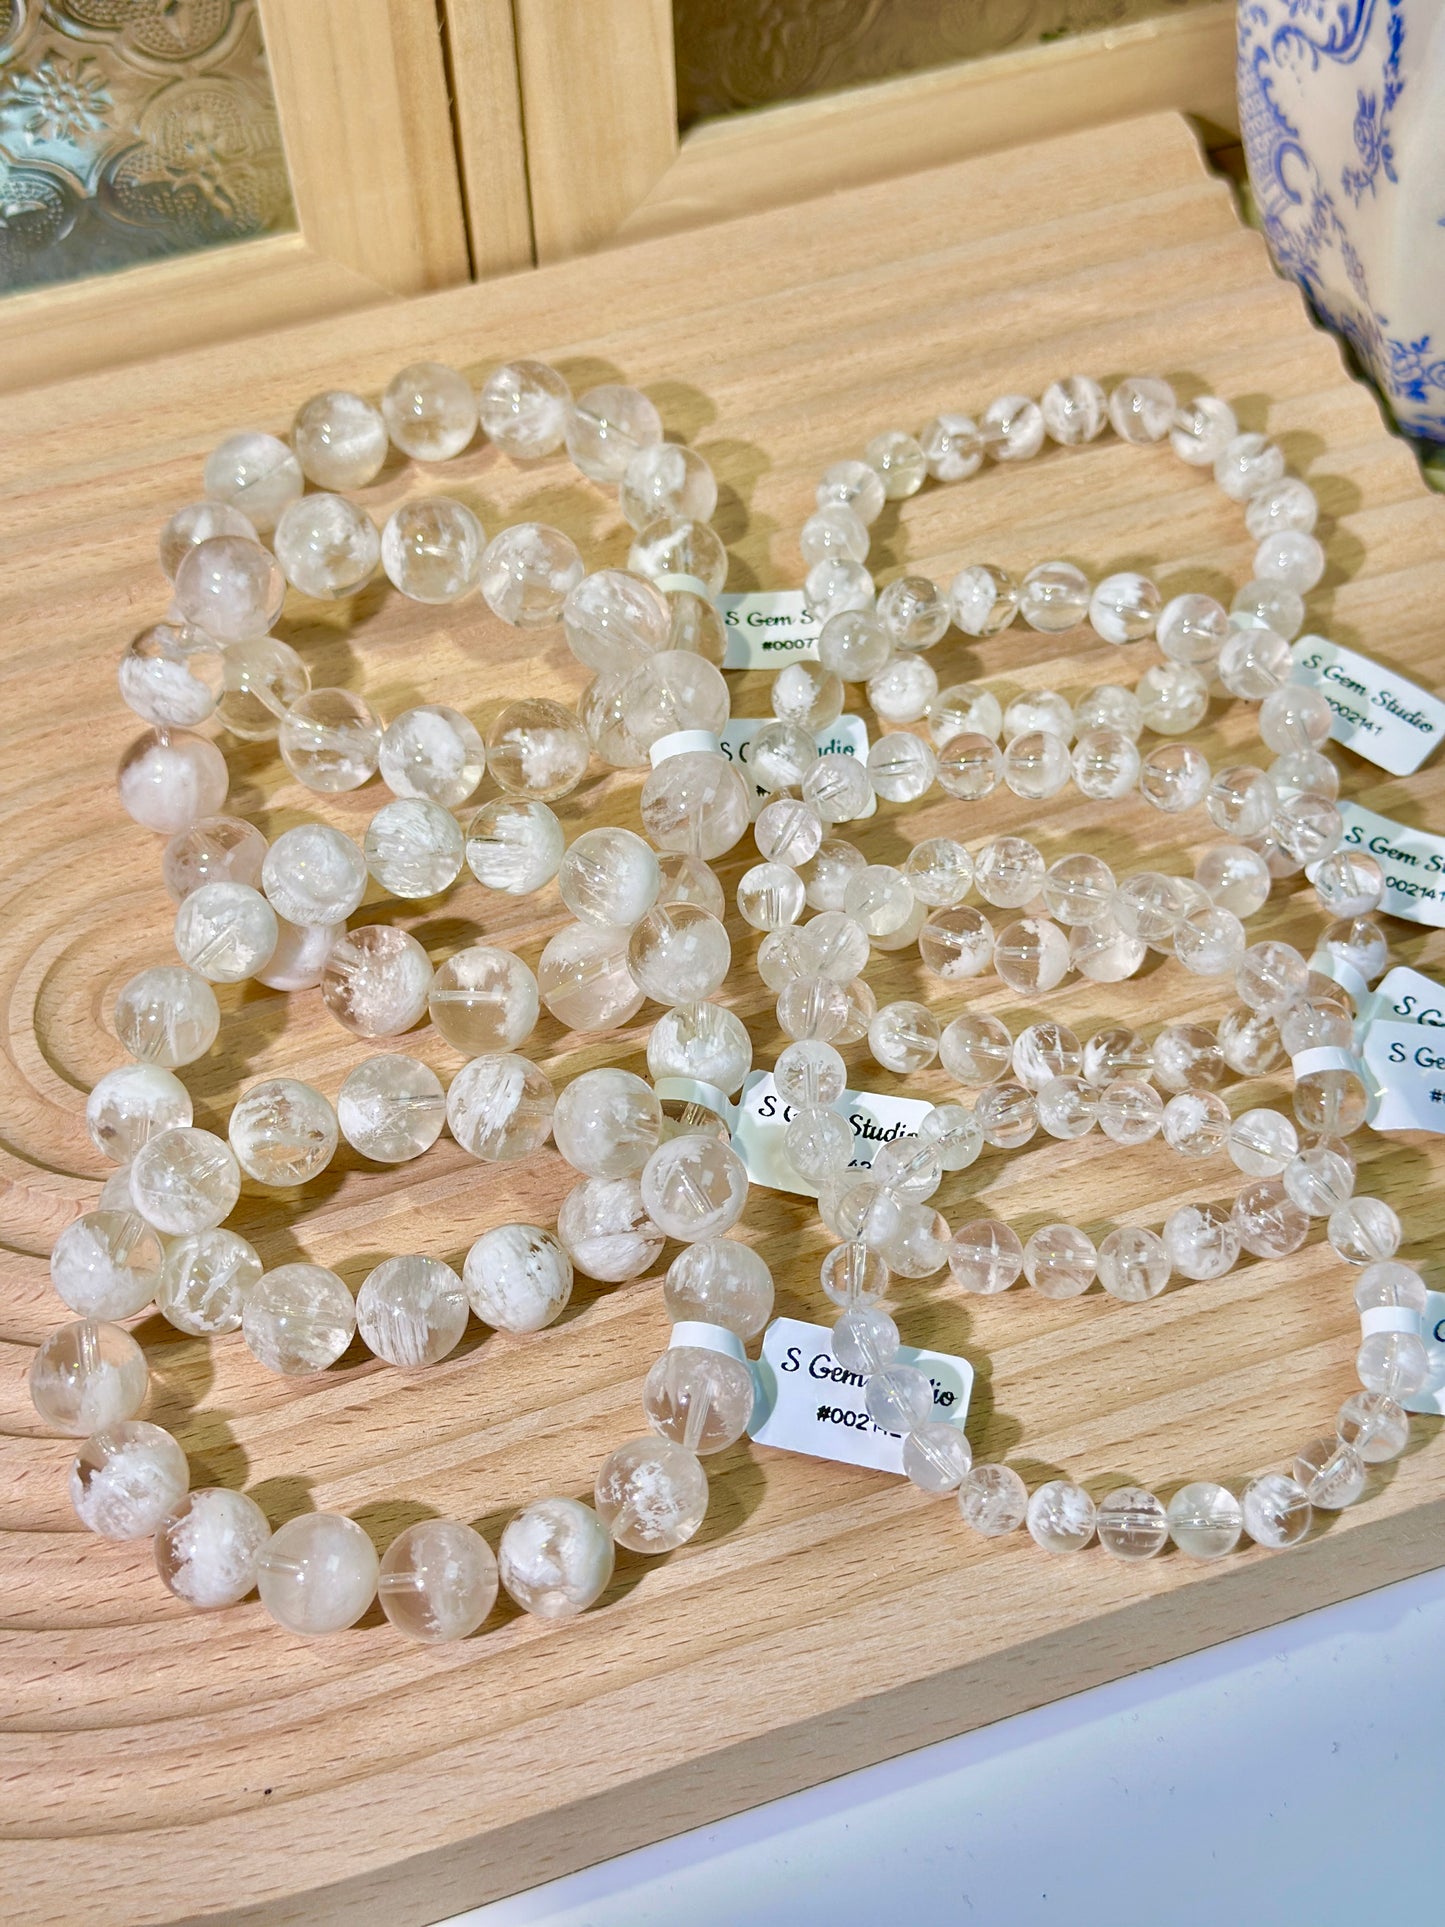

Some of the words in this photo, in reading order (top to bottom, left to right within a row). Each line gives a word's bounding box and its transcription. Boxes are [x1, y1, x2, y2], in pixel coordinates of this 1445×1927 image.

[725, 611, 740, 626] S
[747, 612, 793, 627] Gem
[762, 637, 819, 651] #0007
[1302, 655, 1322, 669] S
[1323, 665, 1367, 696] Gem
[1371, 691, 1434, 733] Studio
[1325, 696, 1382, 736] 002141
[1344, 826, 1364, 844] S
[1369, 836, 1419, 866] Gem
[1393, 996, 1416, 1015] S
[1388, 1043, 1406, 1062] S
[1414, 1047, 1445, 1069] Ge
[758, 1096, 777, 1116] S
[781, 1347, 802, 1372] S
[809, 1354, 868, 1388] Gem
